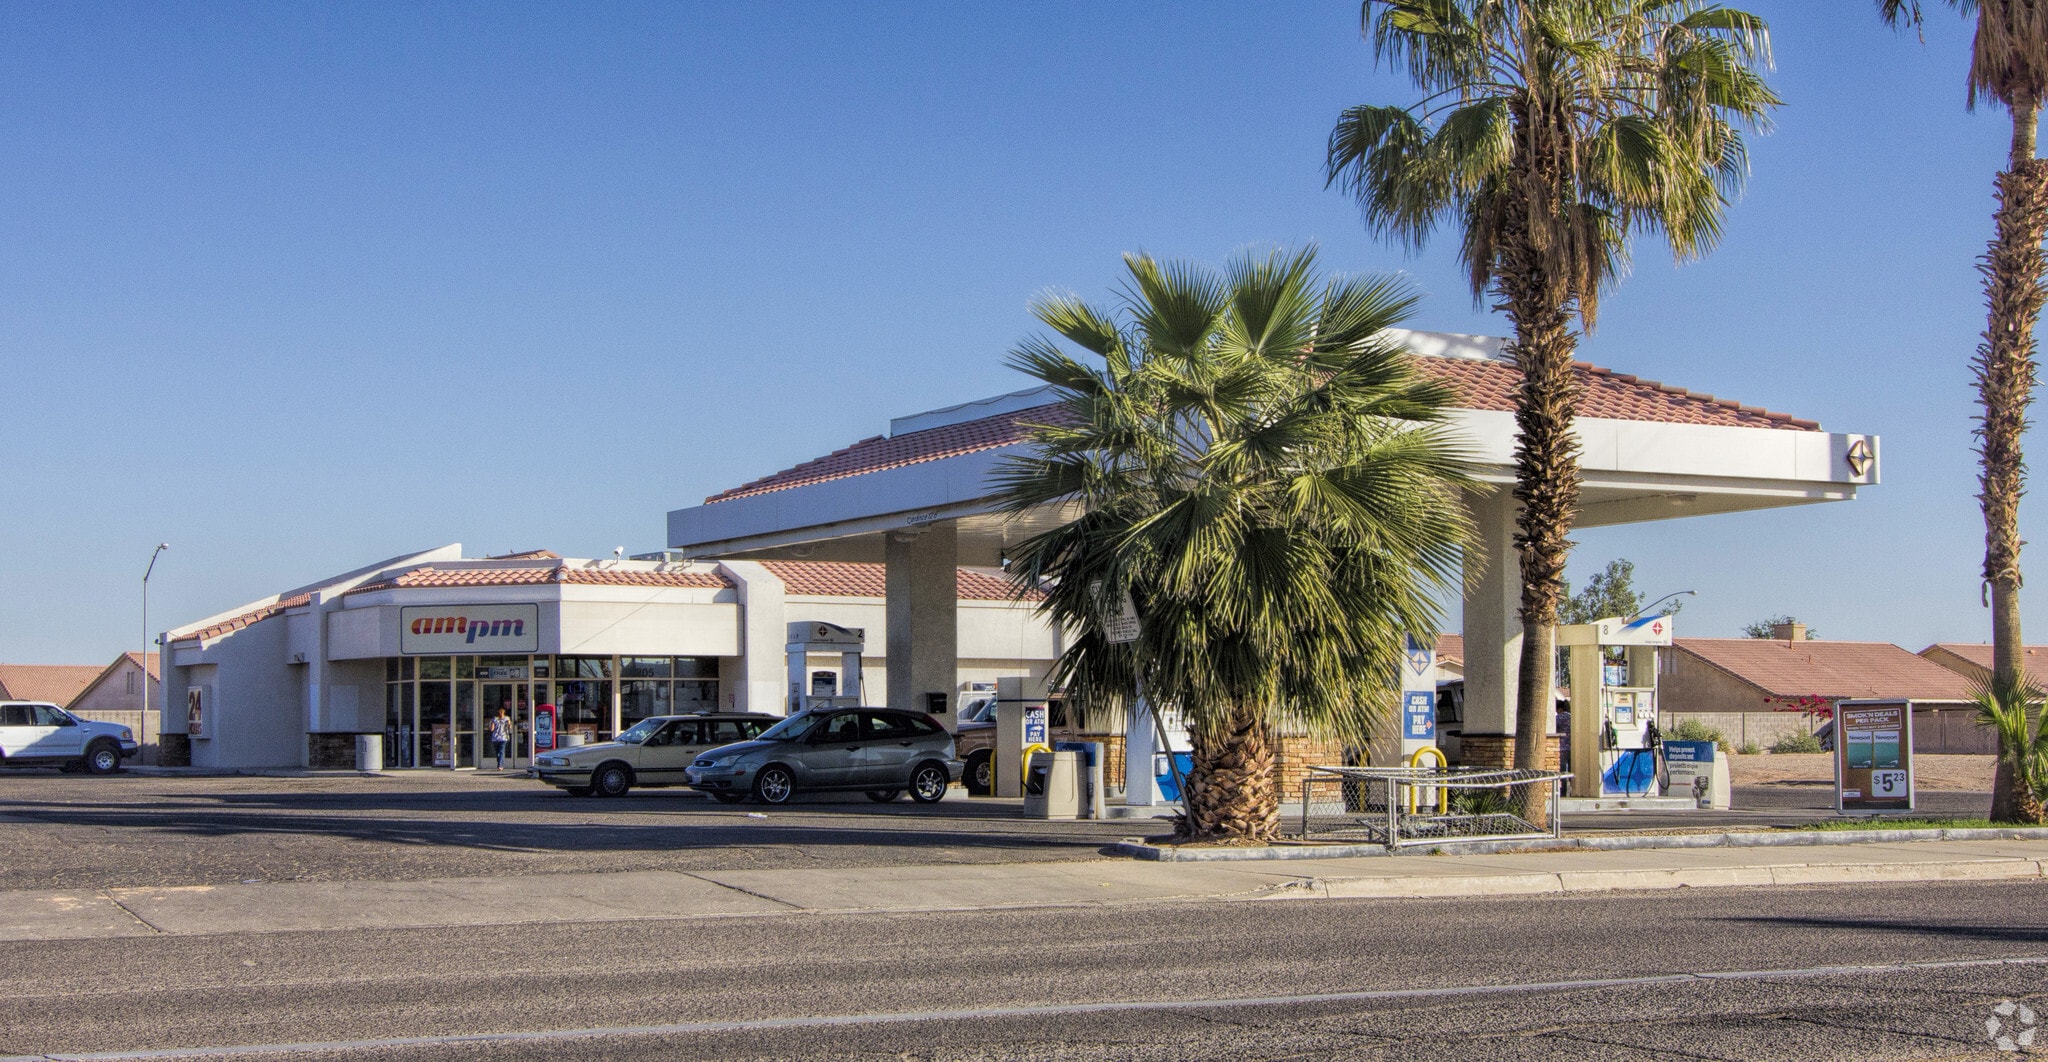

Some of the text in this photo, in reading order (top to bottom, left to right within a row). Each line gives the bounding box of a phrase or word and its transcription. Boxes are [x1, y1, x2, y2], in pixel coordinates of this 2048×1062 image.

[411, 616, 526, 643] ampm
[858, 629, 863, 638] 2
[1604, 625, 1608, 635] 8
[1412, 696, 1428, 704] CASH
[189, 690, 202, 720] 24
[1413, 715, 1425, 724] PAY
[1412, 725, 1426, 734] HERE
